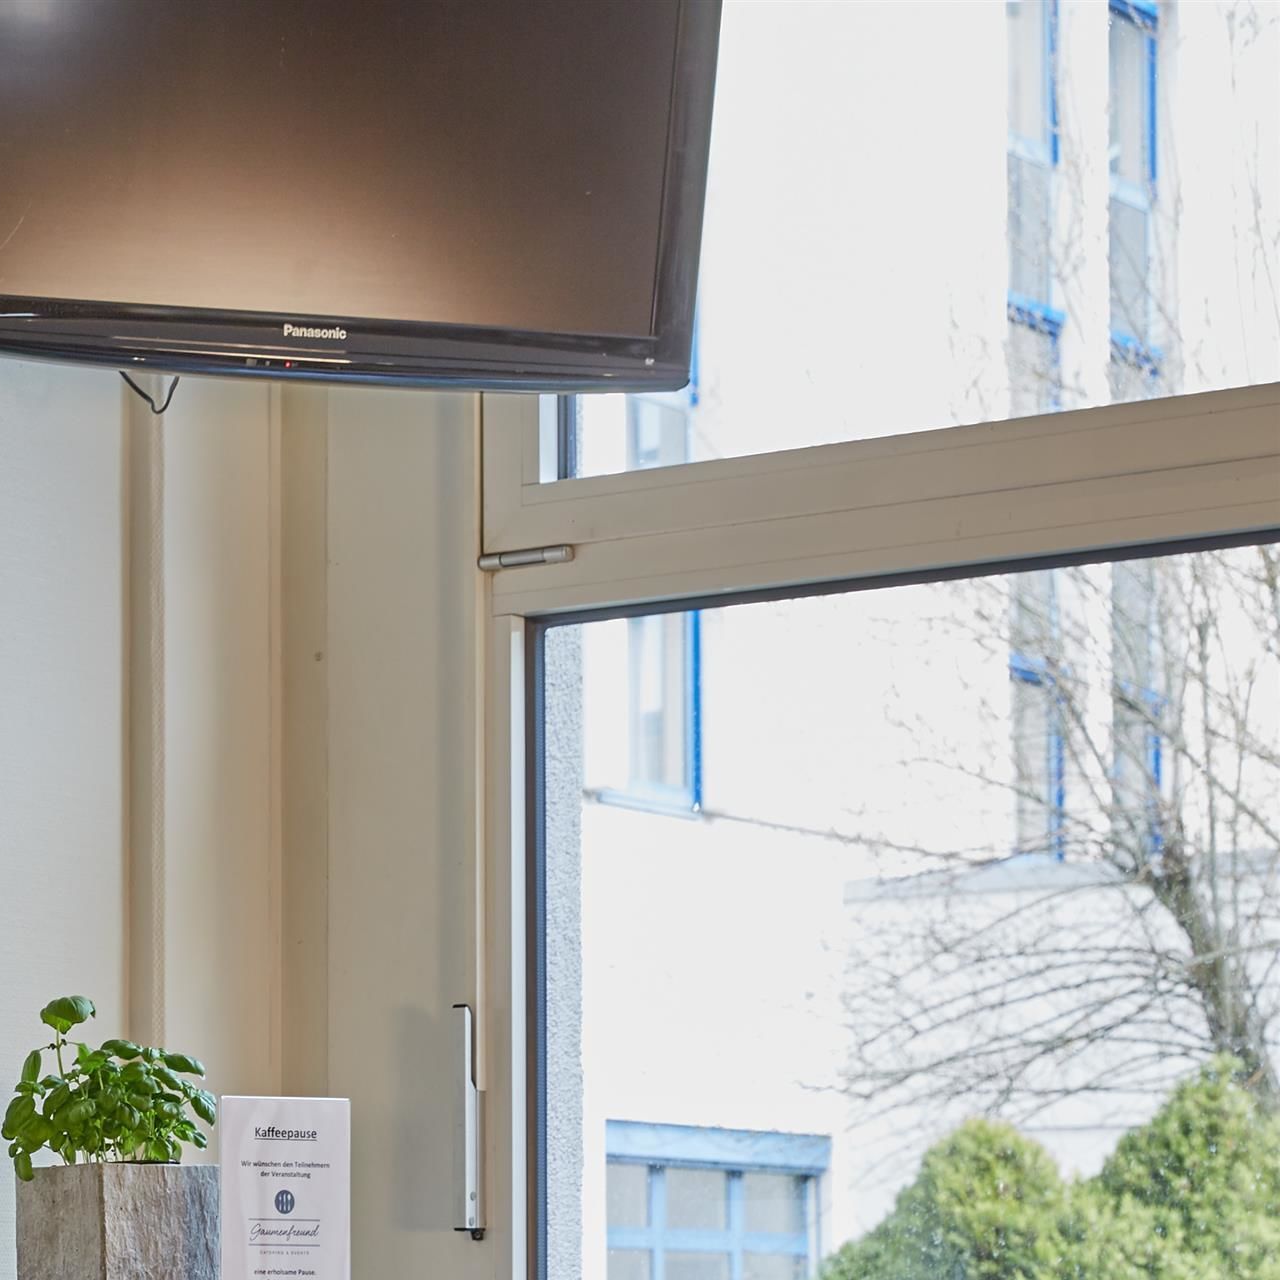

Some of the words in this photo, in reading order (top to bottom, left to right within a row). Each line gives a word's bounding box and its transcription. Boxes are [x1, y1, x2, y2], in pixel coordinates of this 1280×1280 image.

[283, 323, 347, 340] Panasonic
[254, 1126, 318, 1141] Kaffeepause
[253, 1160, 281, 1168] wünschen
[294, 1161, 331, 1169] Teilnehmern
[271, 1171, 311, 1179] Veranstaltung
[250, 1223, 320, 1242] Gaumenfreund
